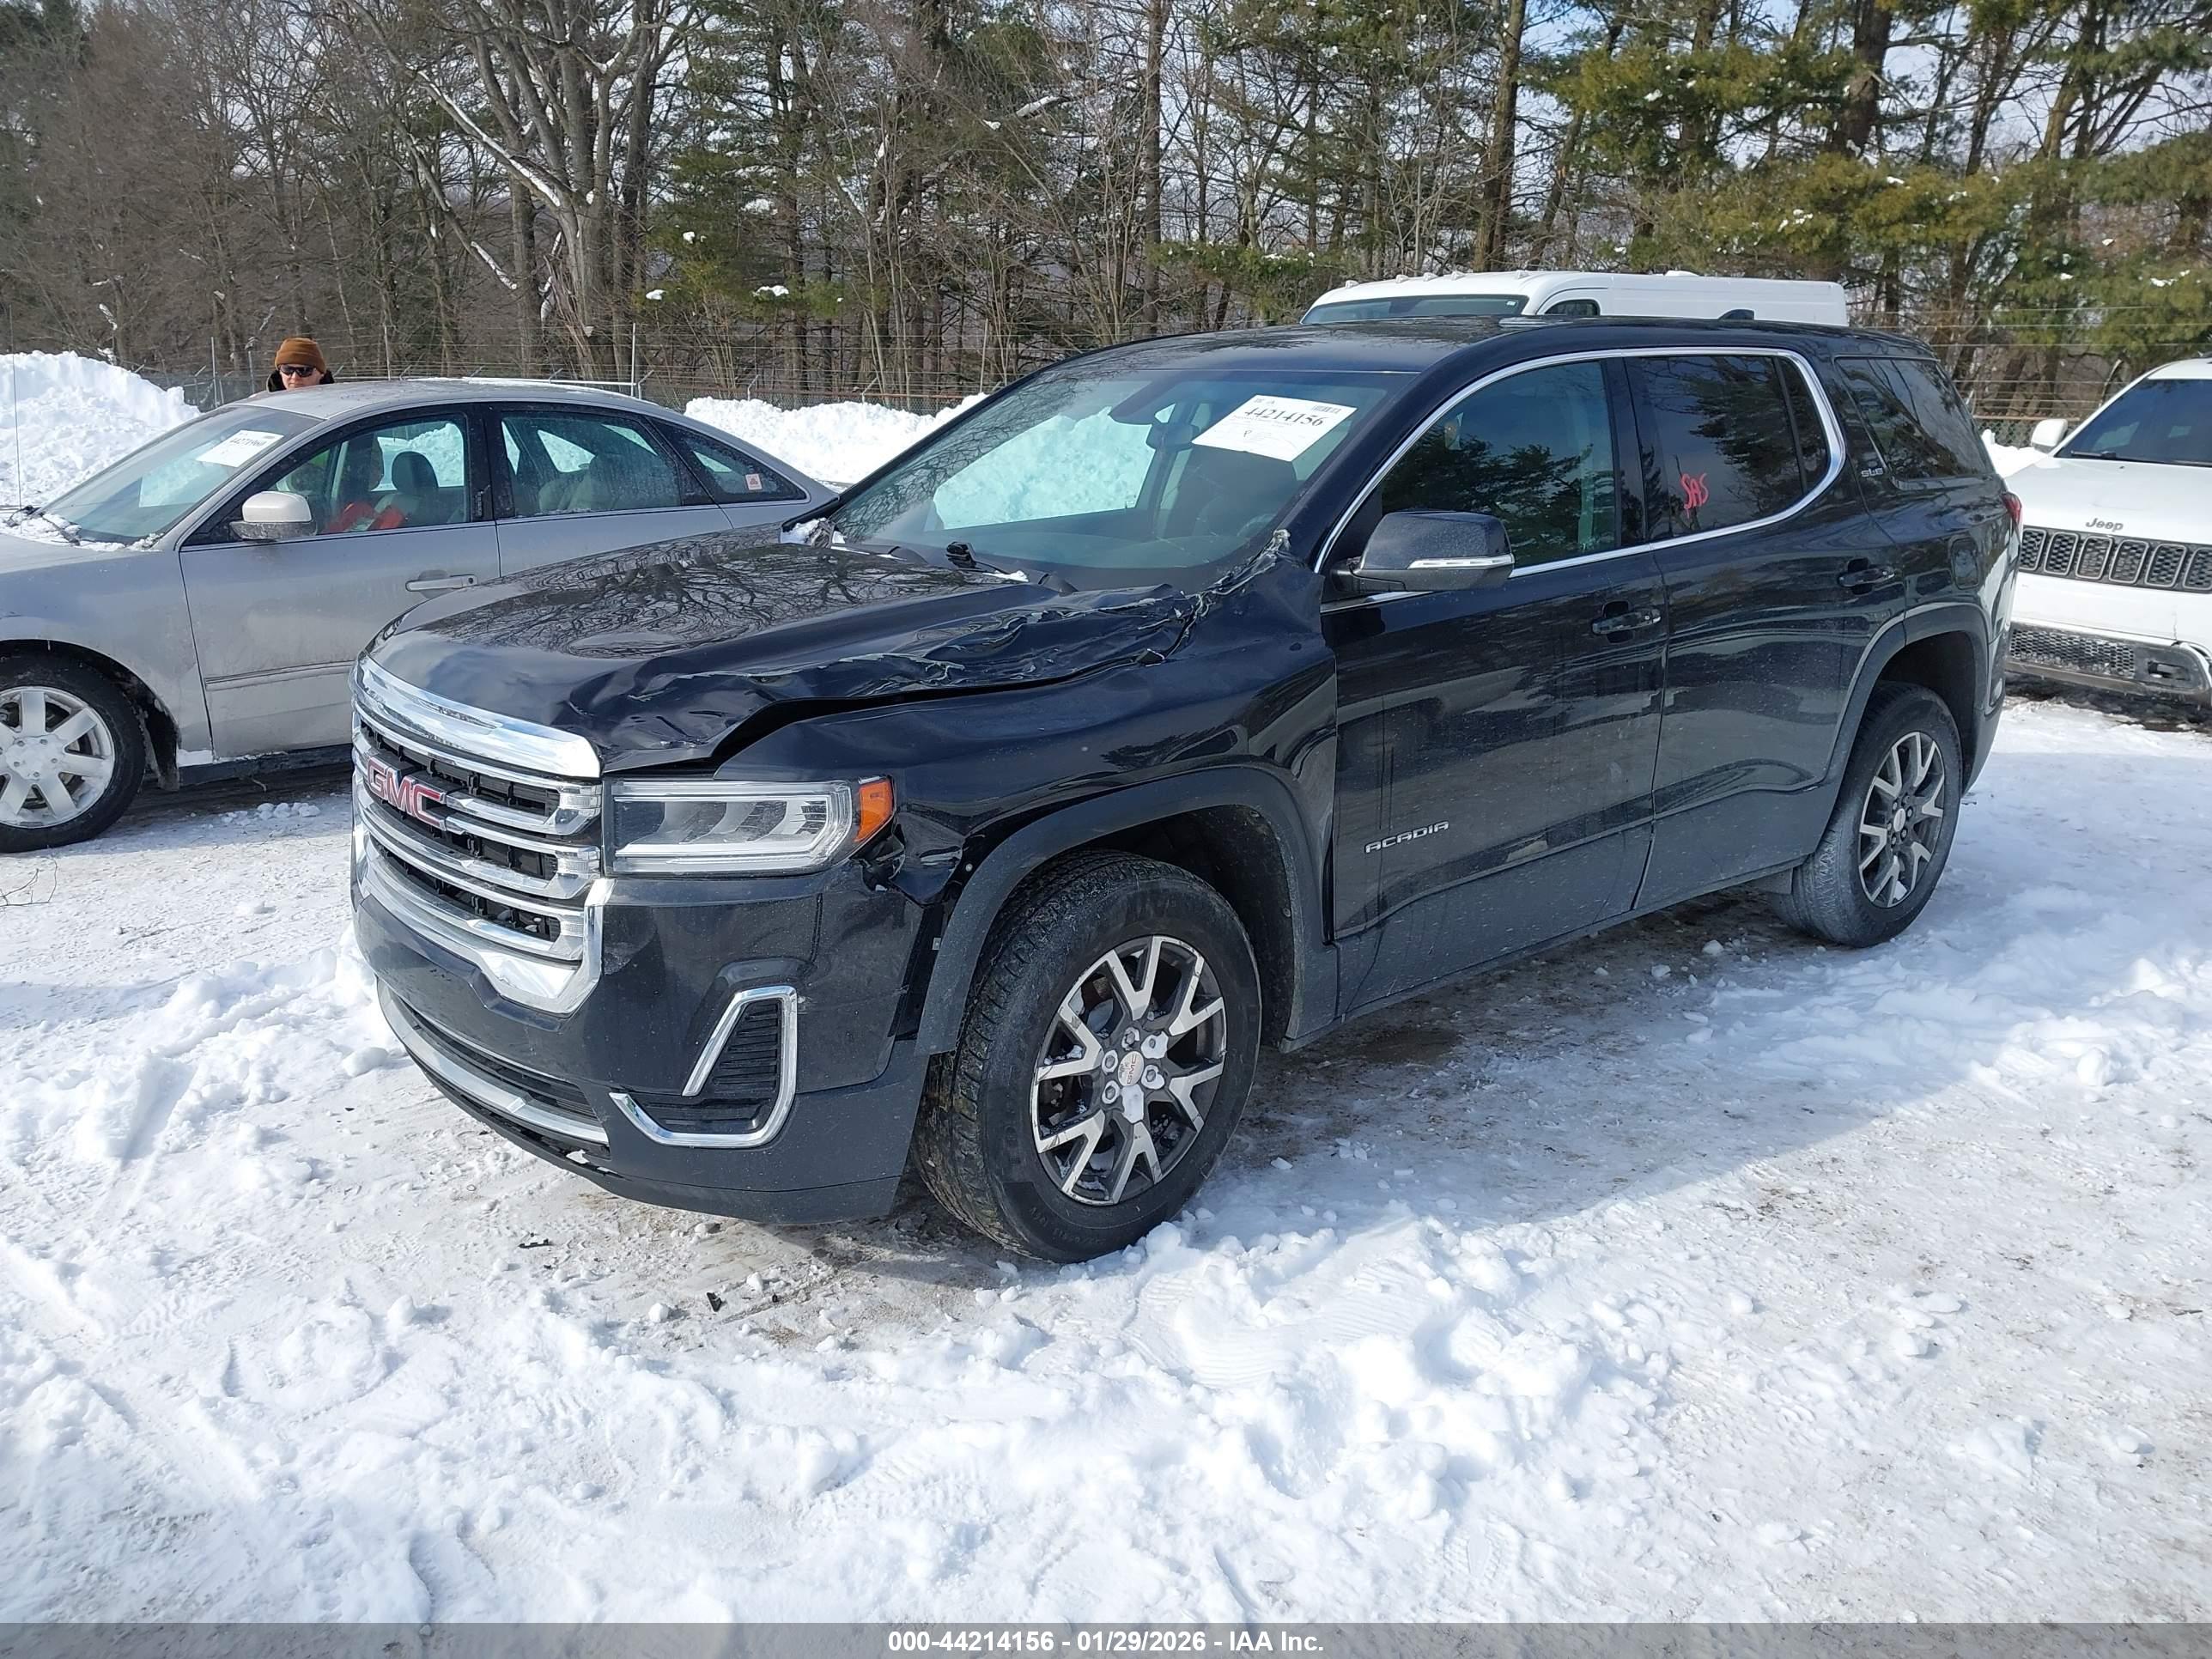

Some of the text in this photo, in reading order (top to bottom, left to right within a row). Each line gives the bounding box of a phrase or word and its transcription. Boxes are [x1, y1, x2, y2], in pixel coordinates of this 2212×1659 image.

[1243, 406, 1328, 427] 44214156
[2085, 517, 2124, 532] Jeep
[368, 757, 447, 832] GMC
[1364, 821, 1449, 854] ACADIA
[1127, 1054, 1137, 1085] GMC
